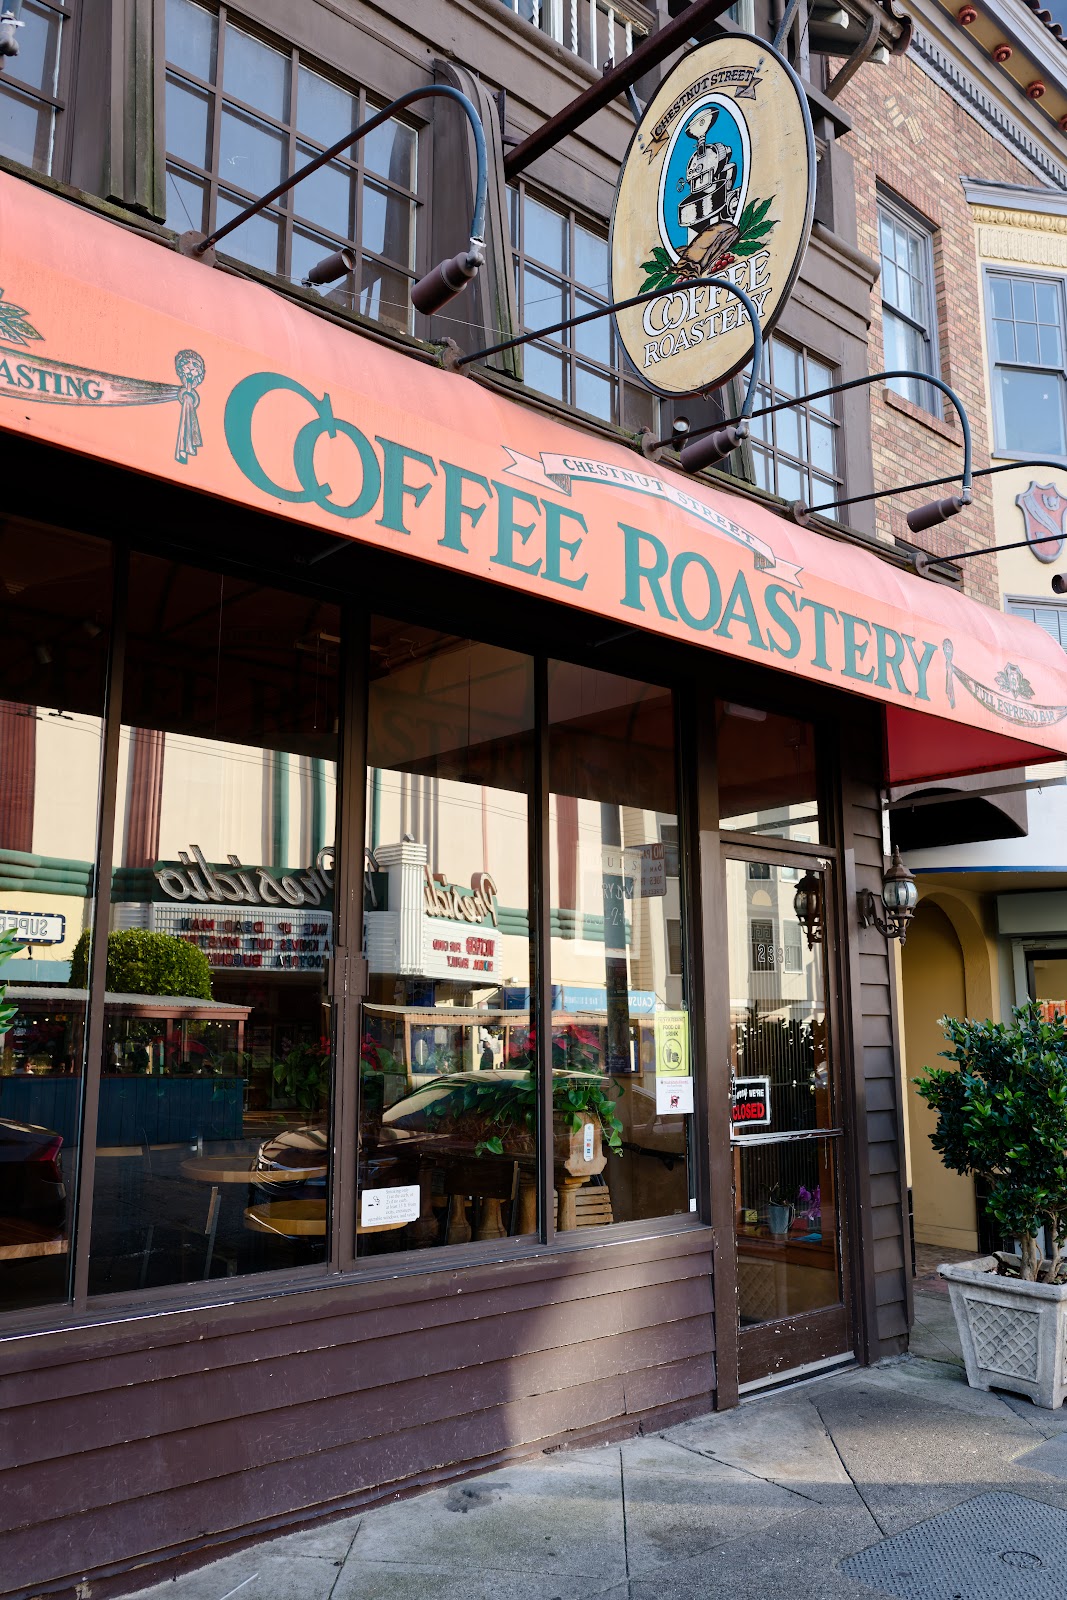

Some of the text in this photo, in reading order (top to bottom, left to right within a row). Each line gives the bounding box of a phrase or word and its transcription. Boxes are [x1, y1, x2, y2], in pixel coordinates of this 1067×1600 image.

[655, 69, 754, 136] CHESTNUT STREET
[643, 250, 770, 337] COFFEE
[562, 457, 756, 546] CHESTNUT STREET
[224, 372, 938, 702] COFFEE ROASTERY
[973, 683, 1056, 723] FULL ESPRESSO BAR
[757, 943, 792, 965] 2331
[732, 1102, 765, 1121] CLOSED
[748, 1088, 765, 1098] WE'RE
